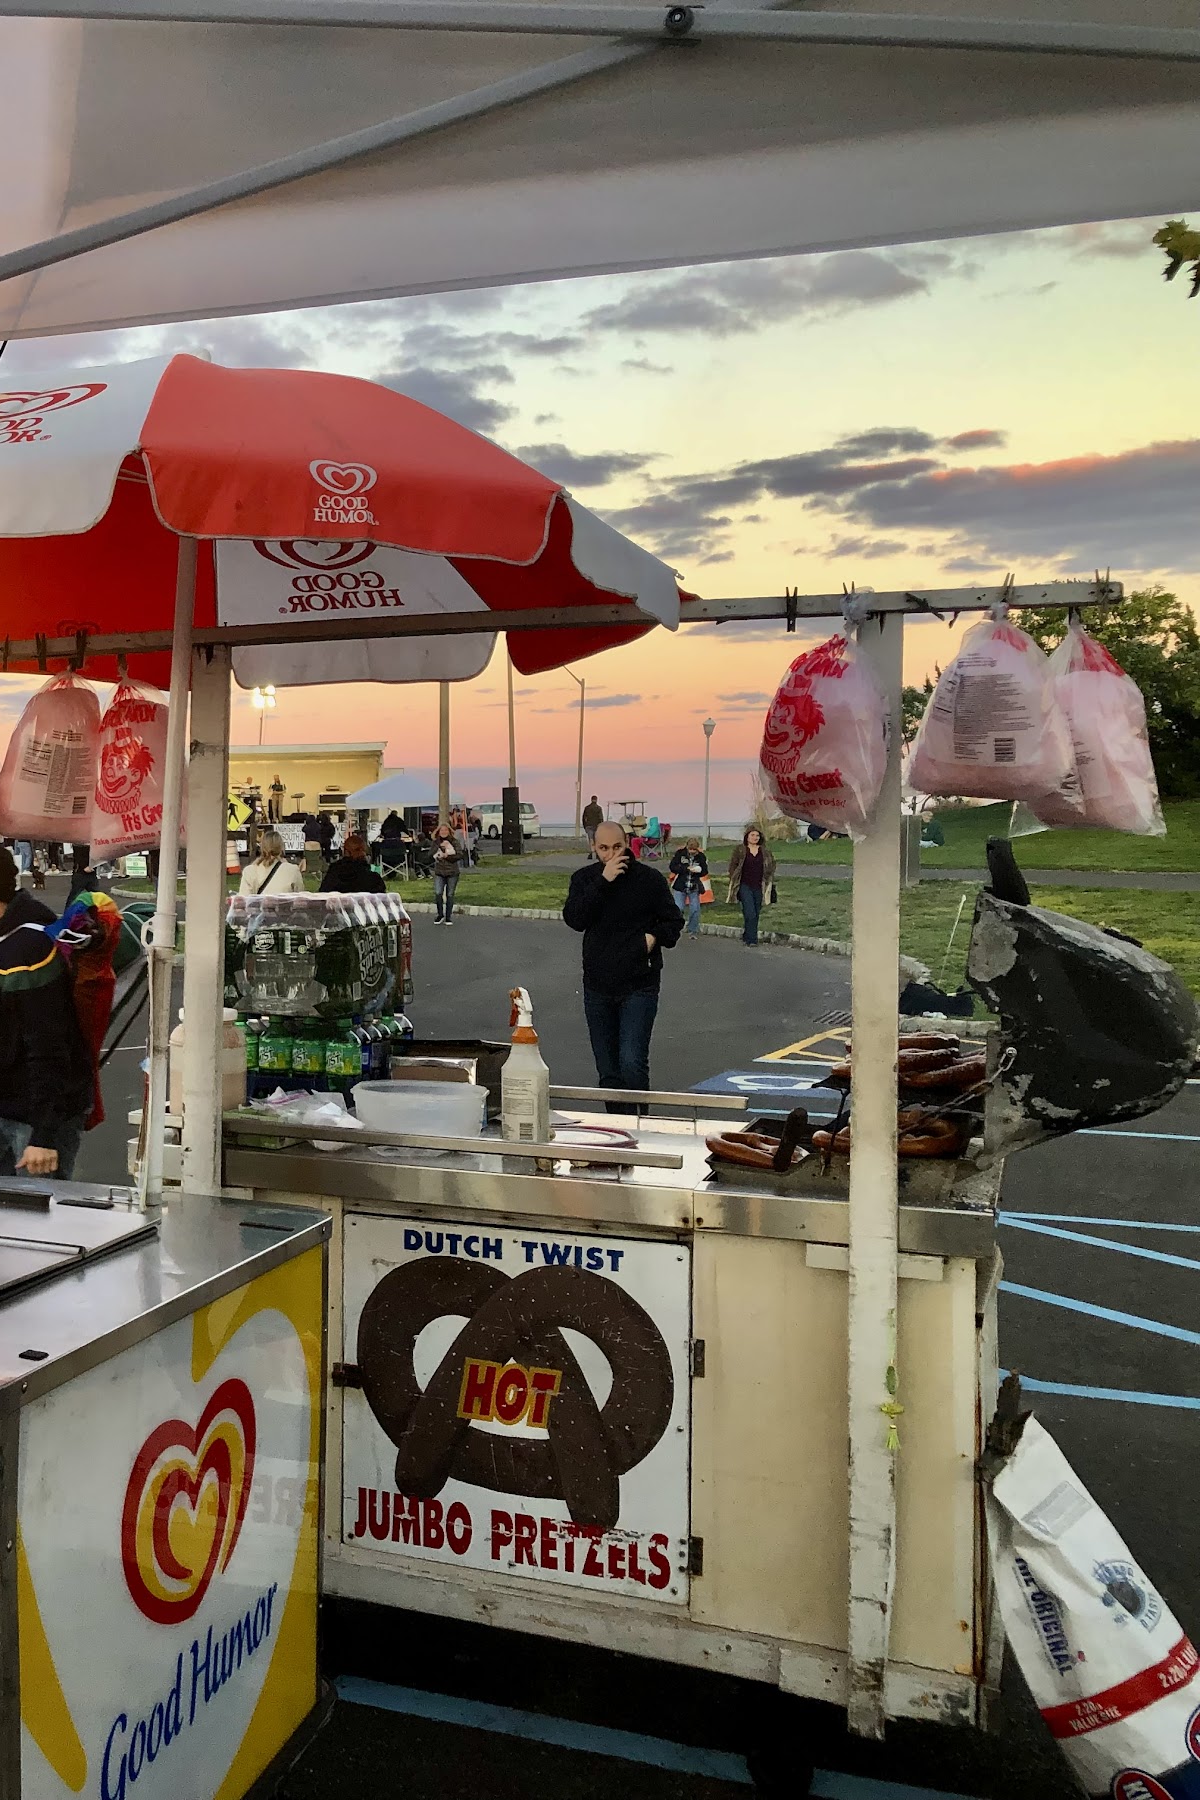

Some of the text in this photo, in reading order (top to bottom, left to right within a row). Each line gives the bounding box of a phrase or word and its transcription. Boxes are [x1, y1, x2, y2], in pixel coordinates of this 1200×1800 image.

[313, 508, 376, 526] HUMOR
[318, 494, 369, 510] GOOD
[141, 803, 163, 826] Gre
[403, 1228, 625, 1273] DUTCH TWIST
[456, 1357, 563, 1430] HOT
[354, 1487, 473, 1556] JUMBO
[490, 1509, 672, 1591] PRETZELS
[101, 1581, 278, 1800] Good Humor
